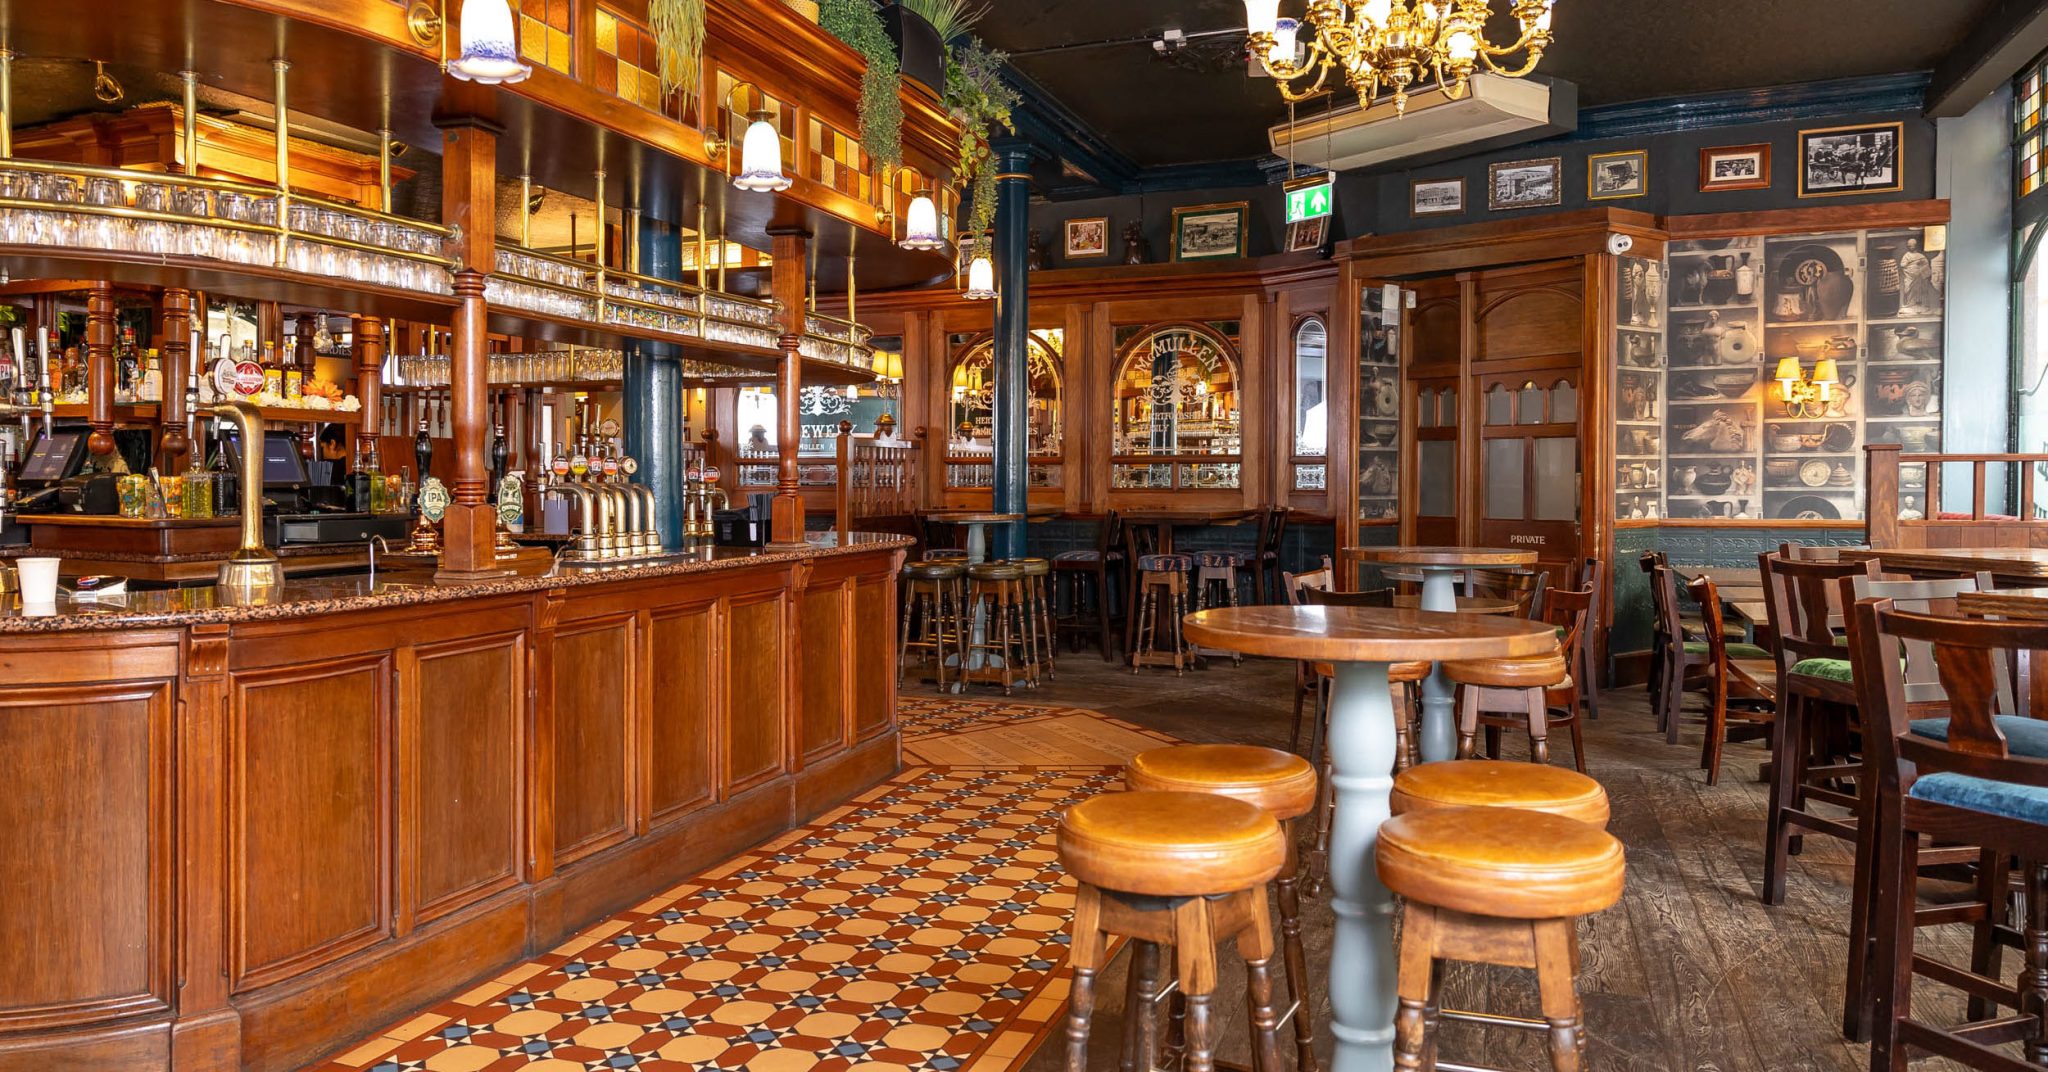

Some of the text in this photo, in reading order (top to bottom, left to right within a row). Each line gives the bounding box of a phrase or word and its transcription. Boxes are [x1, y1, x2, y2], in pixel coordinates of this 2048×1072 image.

[801, 424, 857, 438] EWEY
[428, 492, 442, 502] IPA
[1510, 535, 1546, 545] PRIVATE
